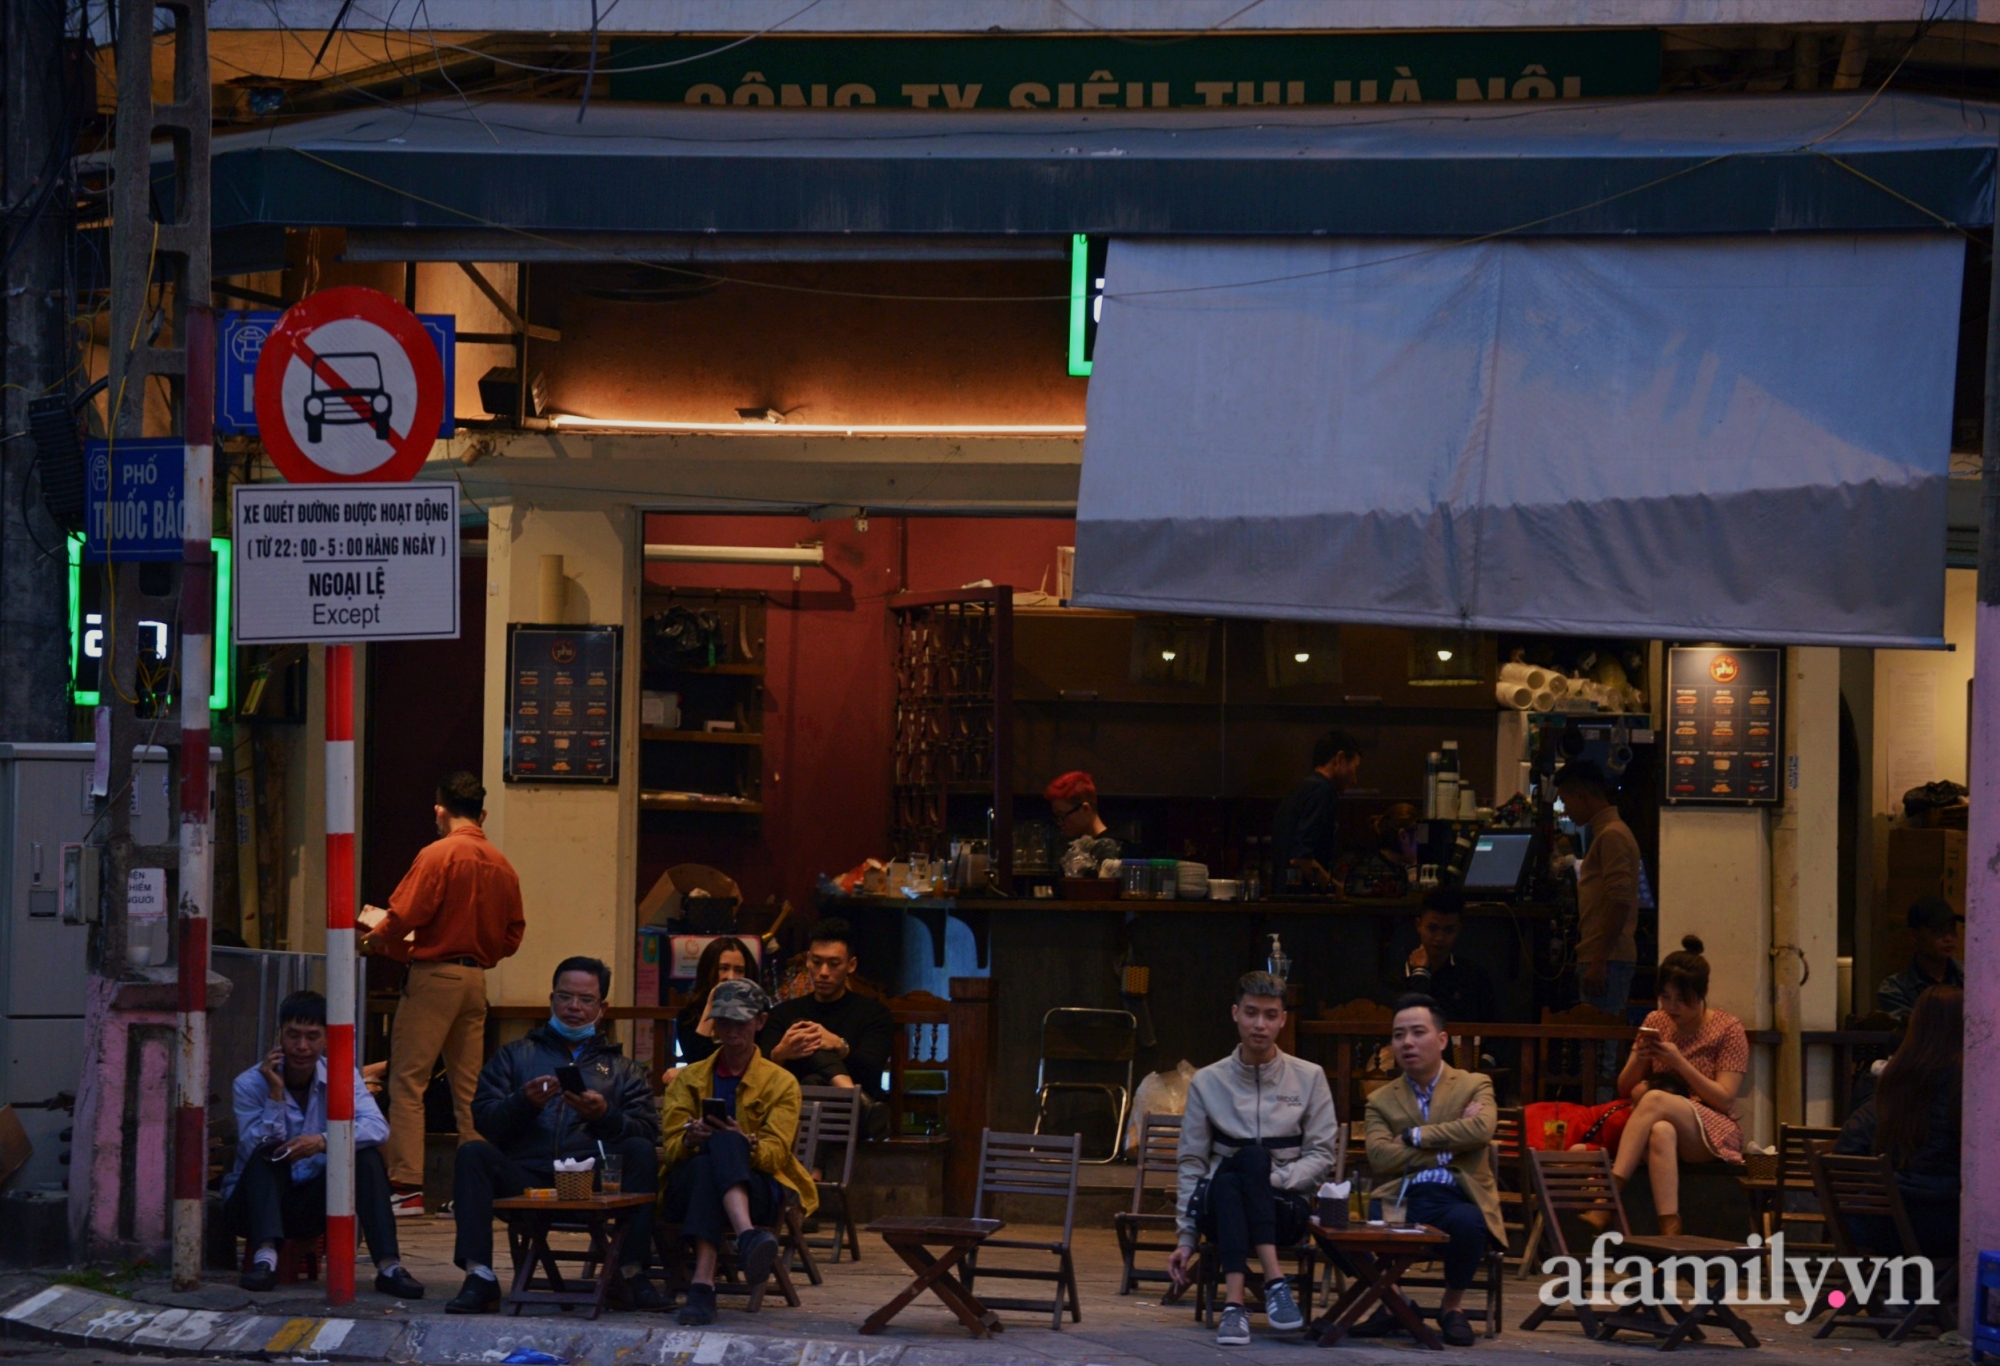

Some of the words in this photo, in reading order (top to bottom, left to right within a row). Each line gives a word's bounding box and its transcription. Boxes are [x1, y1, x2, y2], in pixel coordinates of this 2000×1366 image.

[122, 453, 158, 485] PHỐ
[93, 487, 148, 540] THUỐC
[243, 504, 260, 524] XE
[263, 500, 294, 523] QUÉT
[298, 499, 340, 523] ĐƯỜNG
[344, 501, 377, 526] ĐƯỢC
[381, 502, 412, 526] HOẠT
[415, 498, 449, 526] ĐỘNG
[366, 533, 399, 556] HÀNG
[309, 572, 361, 600] NGOẠI
[366, 566, 385, 600] LỆ
[313, 603, 380, 629] Except
[128, 869, 145, 881] IỆN
